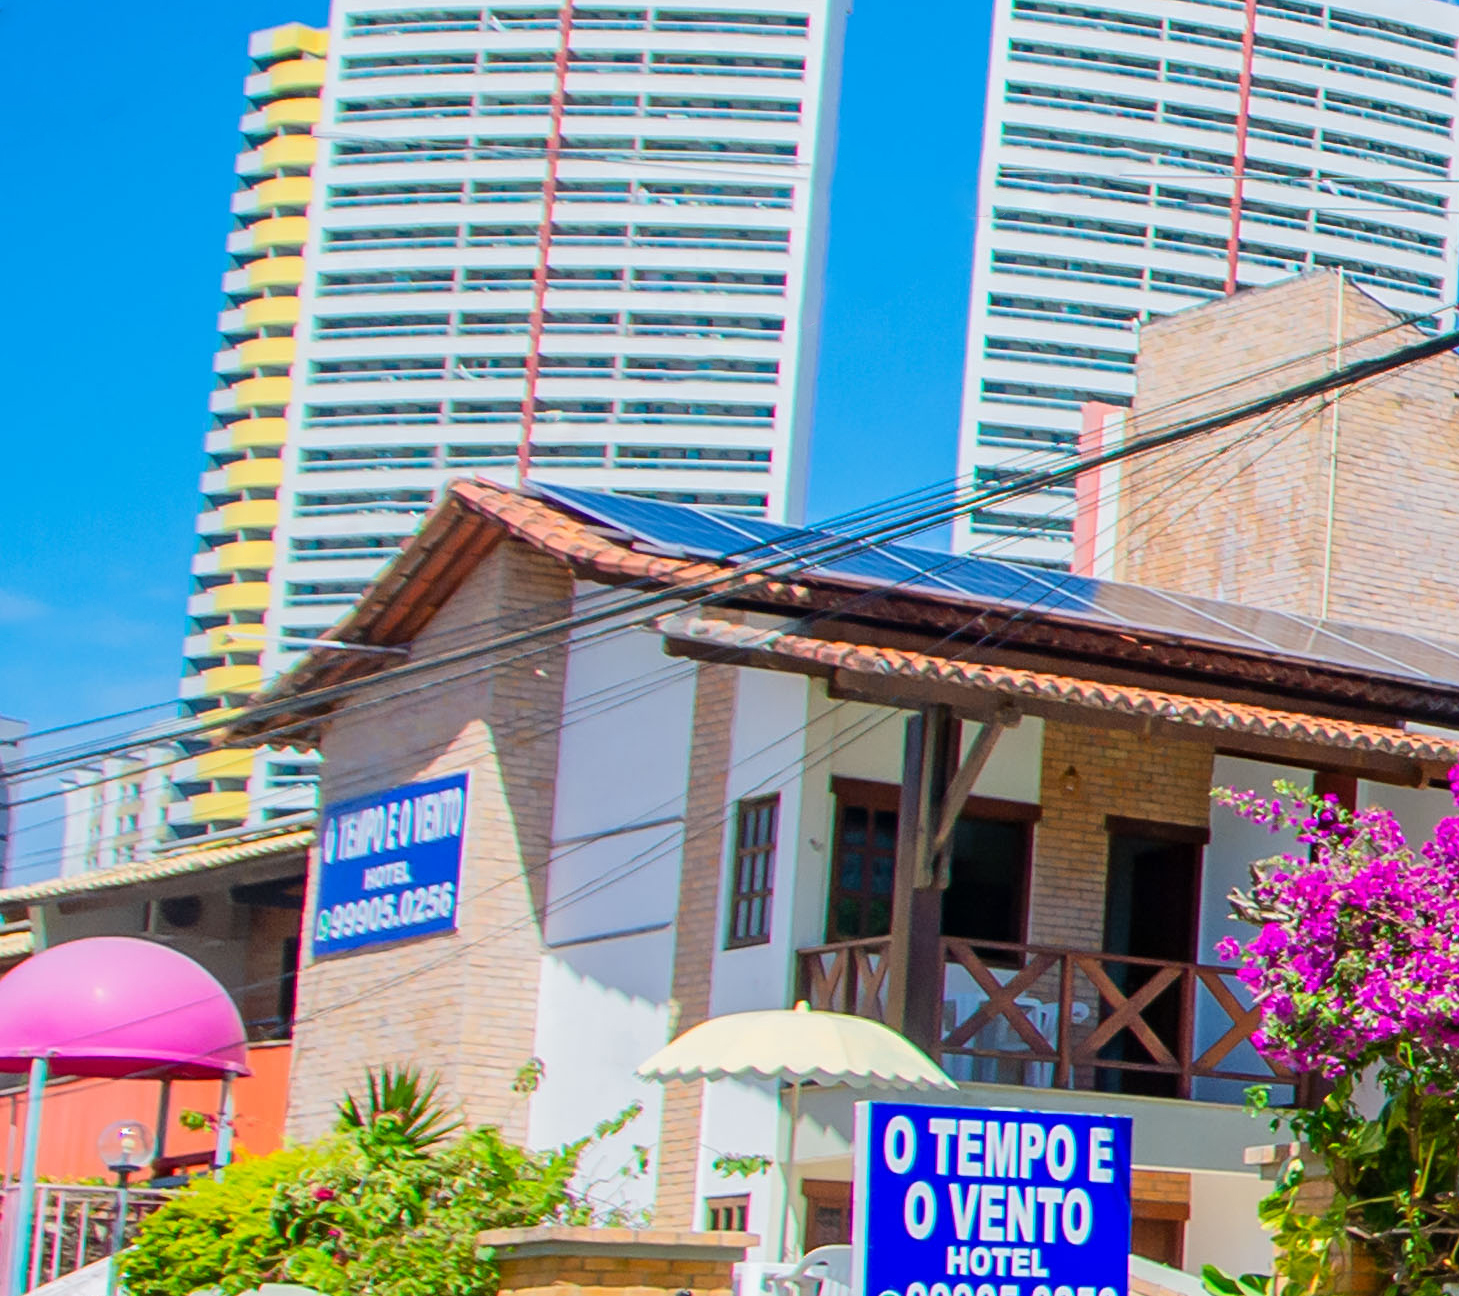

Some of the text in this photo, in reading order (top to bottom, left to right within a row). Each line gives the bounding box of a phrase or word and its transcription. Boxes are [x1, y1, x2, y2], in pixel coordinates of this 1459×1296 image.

[323, 787, 464, 864] O TEMPO E O VENTO
[363, 861, 412, 891] HOTEL
[330, 881, 456, 939] 99905.0256
[884, 1115, 1114, 1183] O TEMPO E
[904, 1181, 1093, 1245] O VENTO
[946, 1246, 1049, 1278] HOTEL
